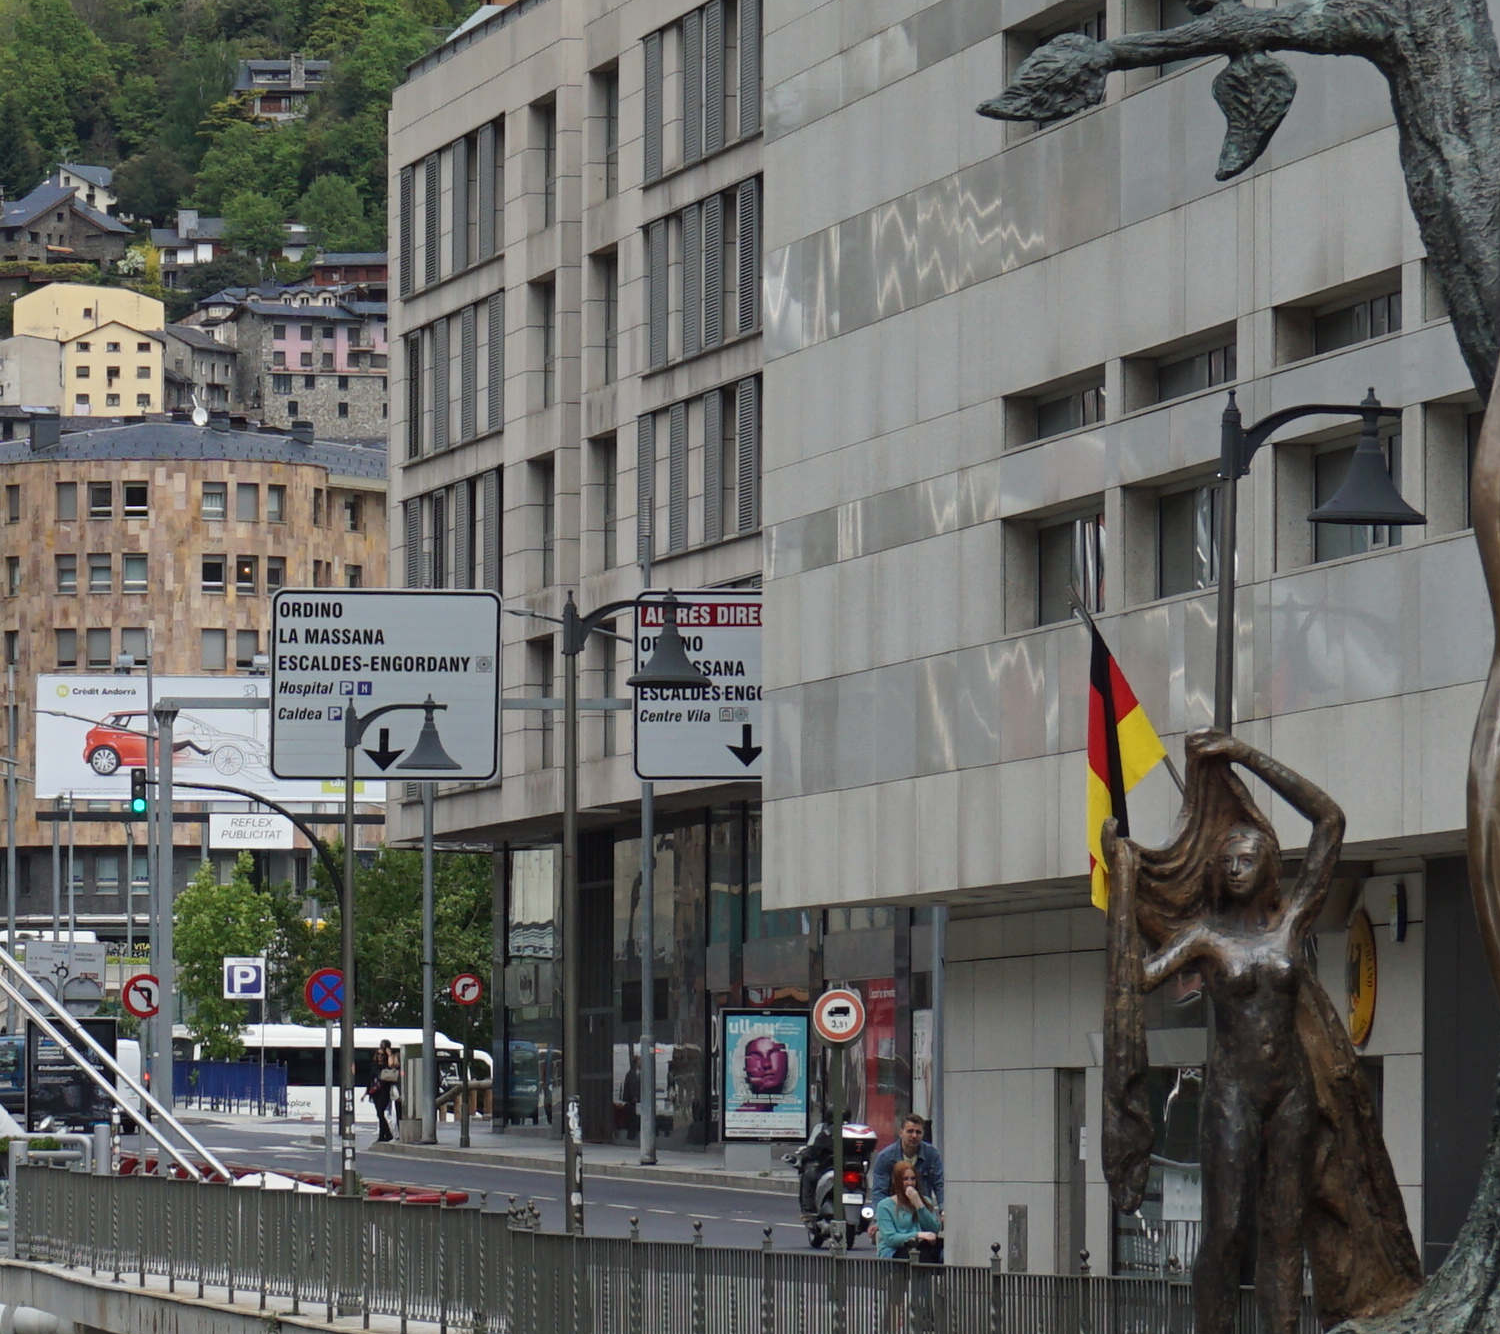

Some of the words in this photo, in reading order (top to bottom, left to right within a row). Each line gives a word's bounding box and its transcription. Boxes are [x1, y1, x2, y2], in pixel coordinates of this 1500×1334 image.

[279, 601, 343, 618] ORDINO
[645, 606, 710, 624] ALRES
[279, 628, 299, 644] LA
[304, 628, 385, 645] MASSANA
[278, 655, 471, 672] ESCALDES-ENGORDANY
[278, 681, 333, 697] Hospital
[278, 707, 322, 721] Caldea
[640, 709, 682, 722] Centre
[687, 709, 711, 722] Vila
[231, 817, 273, 827] REFLEX
[221, 829, 282, 839] PUBLICITAT
[234, 966, 257, 993] P
